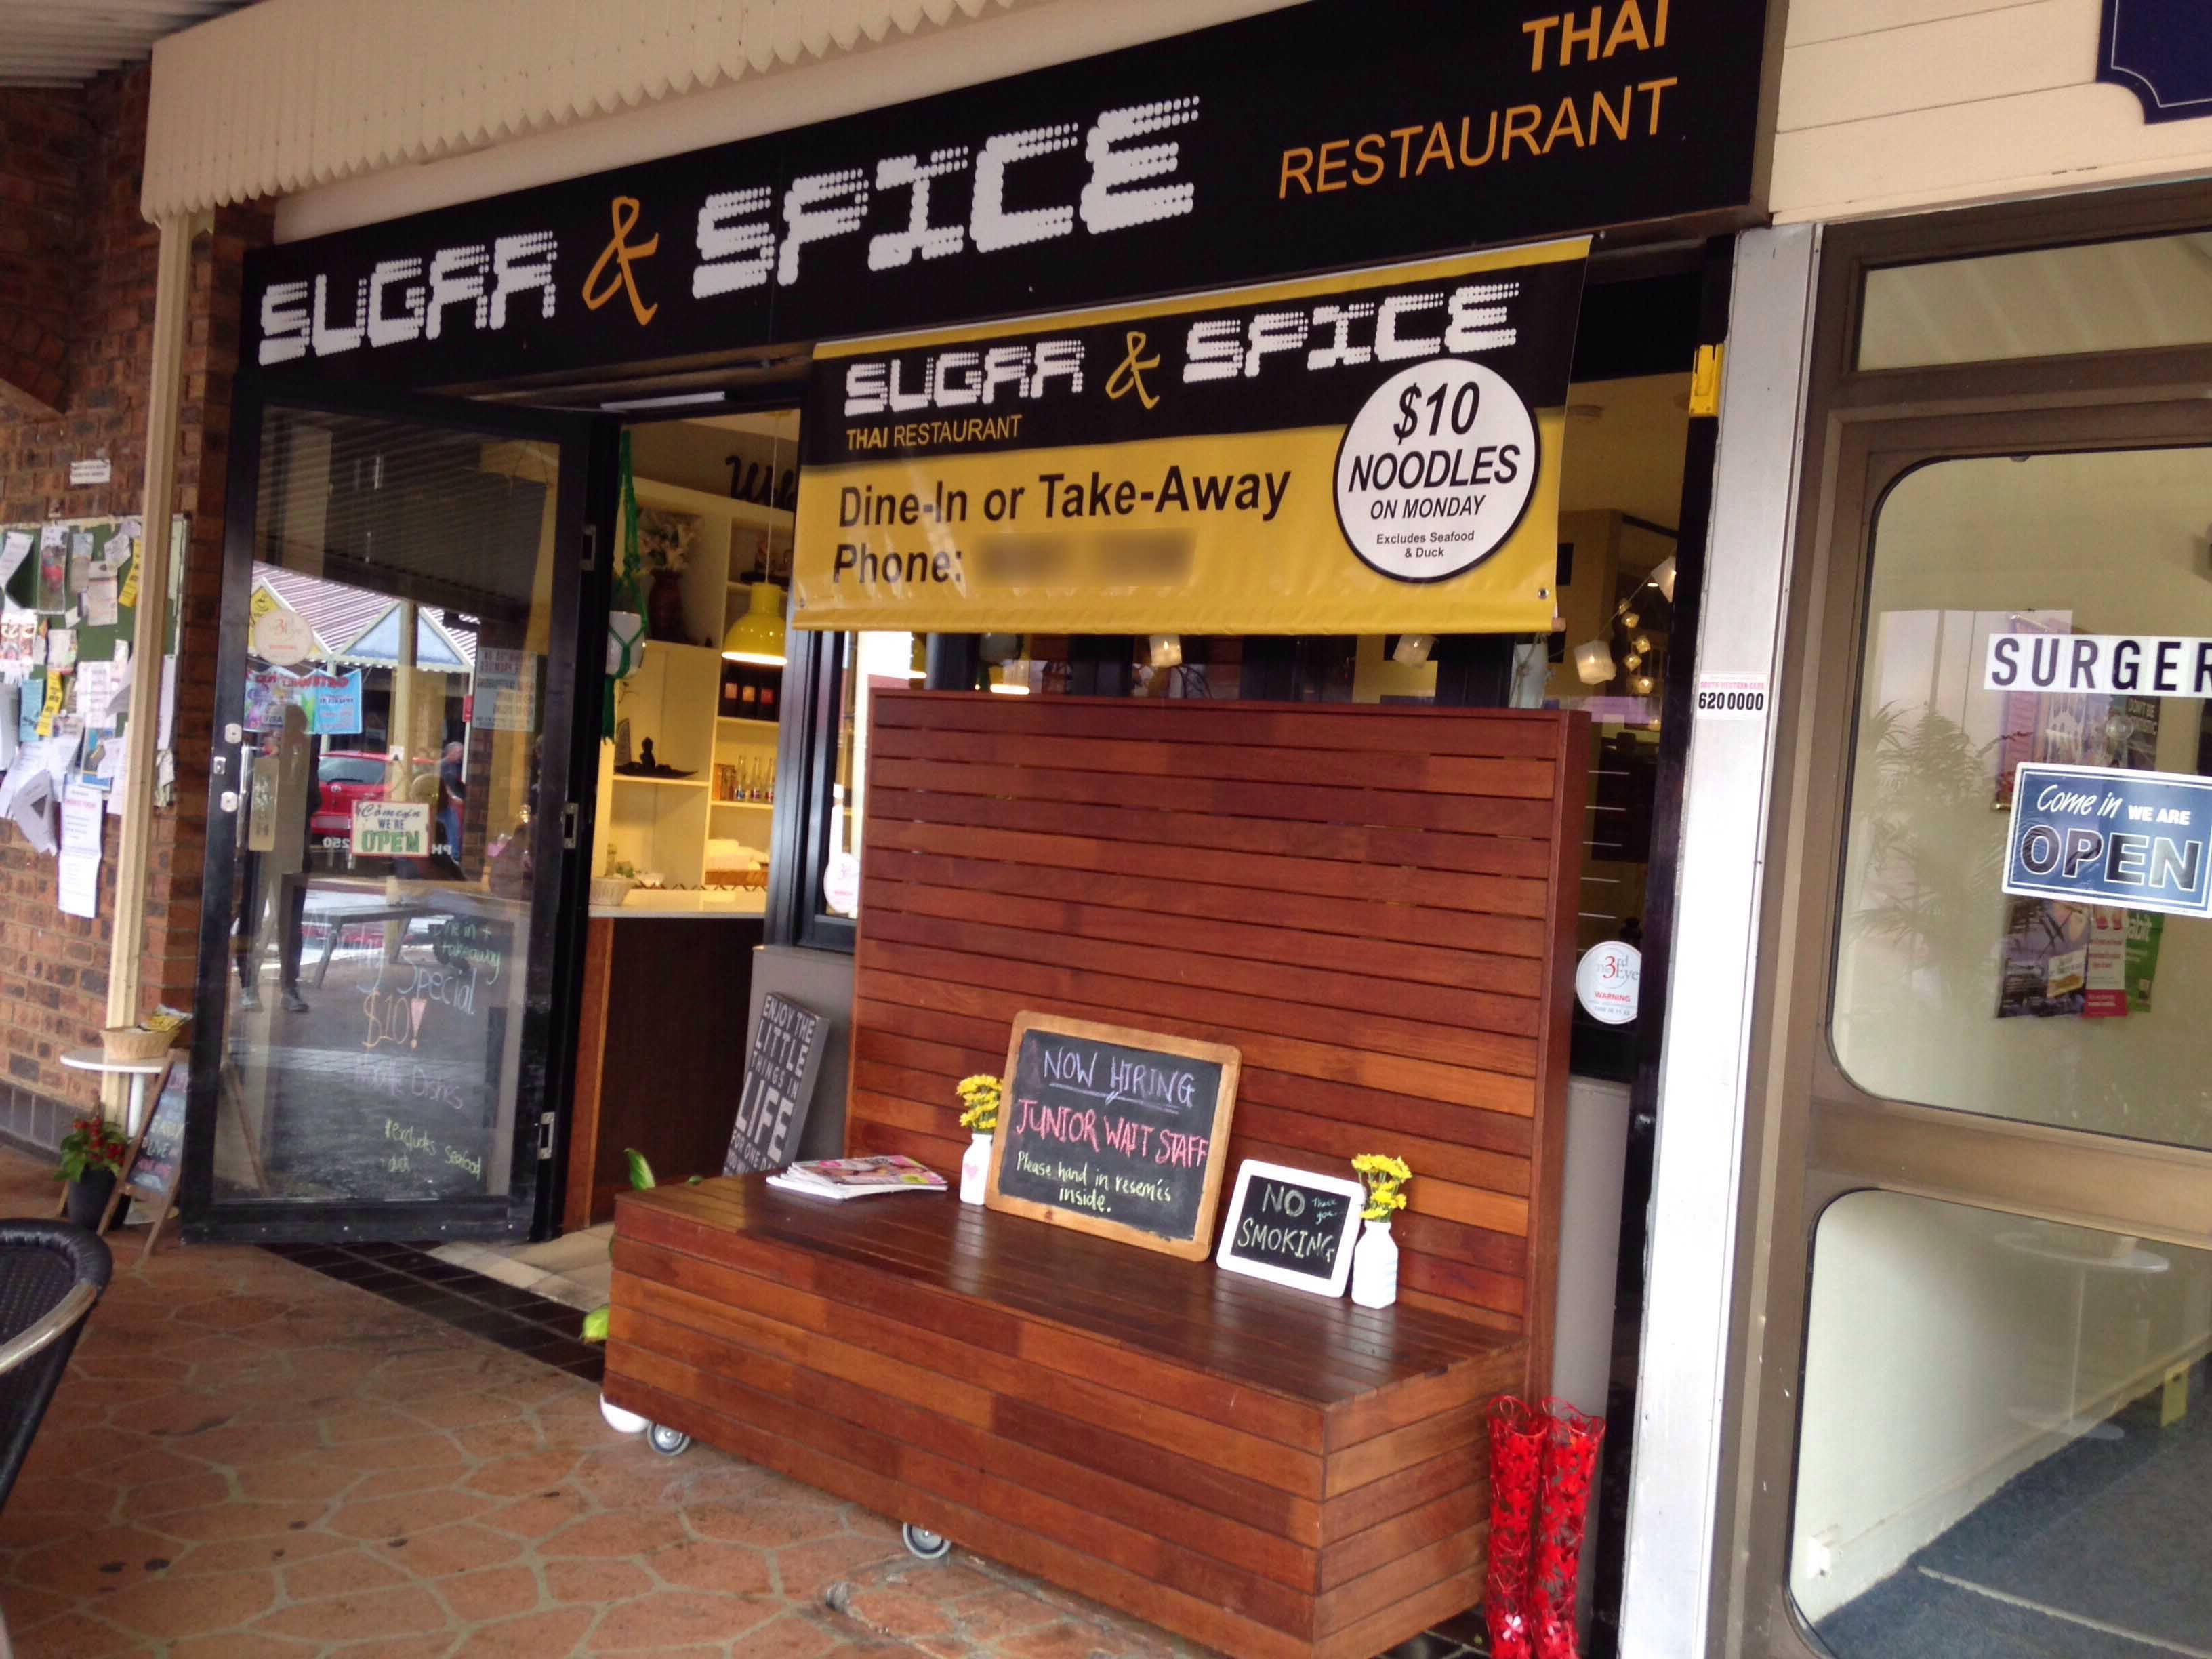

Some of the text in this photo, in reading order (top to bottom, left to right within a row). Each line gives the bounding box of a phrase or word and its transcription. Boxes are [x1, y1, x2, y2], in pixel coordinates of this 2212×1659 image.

[1522, 0, 1670, 73] THAI
[1279, 76, 1678, 199] RESTAURANT
[258, 96, 1200, 367] SUGAR & SPICE
[844, 281, 1520, 417] SUGAR & SPICE
[846, 415, 1023, 451] THAI RESTAURANT
[1393, 380, 1481, 445] $10
[1347, 444, 1521, 493] NOODLES
[839, 465, 1293, 527] Dine-In or Take-Away
[1370, 495, 1486, 519] ON MONDAY
[1376, 529, 1475, 544] Excludes Seafood
[1404, 547, 1444, 558] & Duck
[833, 542, 962, 584] Phone:
[2037, 785, 2191, 825] Come in WE ARE
[361, 830, 420, 853] OPEN
[2020, 825, 2202, 893] OPEN
[763, 995, 815, 1044] ENJOY THE
[1595, 991, 1633, 1003] WARNING
[755, 1019, 808, 1078] LITTLE
[751, 1050, 801, 1100] THINGS IN
[1044, 1046, 1196, 1108] NOW HIRING
[735, 1071, 794, 1164] LIFE
[1017, 1099, 1210, 1168] JUNIOR WAIT STAFF
[1017, 1150, 1051, 1177] Please
[1058, 1161, 1088, 1187] hand
[1096, 1168, 1109, 1191] in
[1262, 1183, 1306, 1218] NO
[1237, 1217, 1335, 1263] SMOKING
